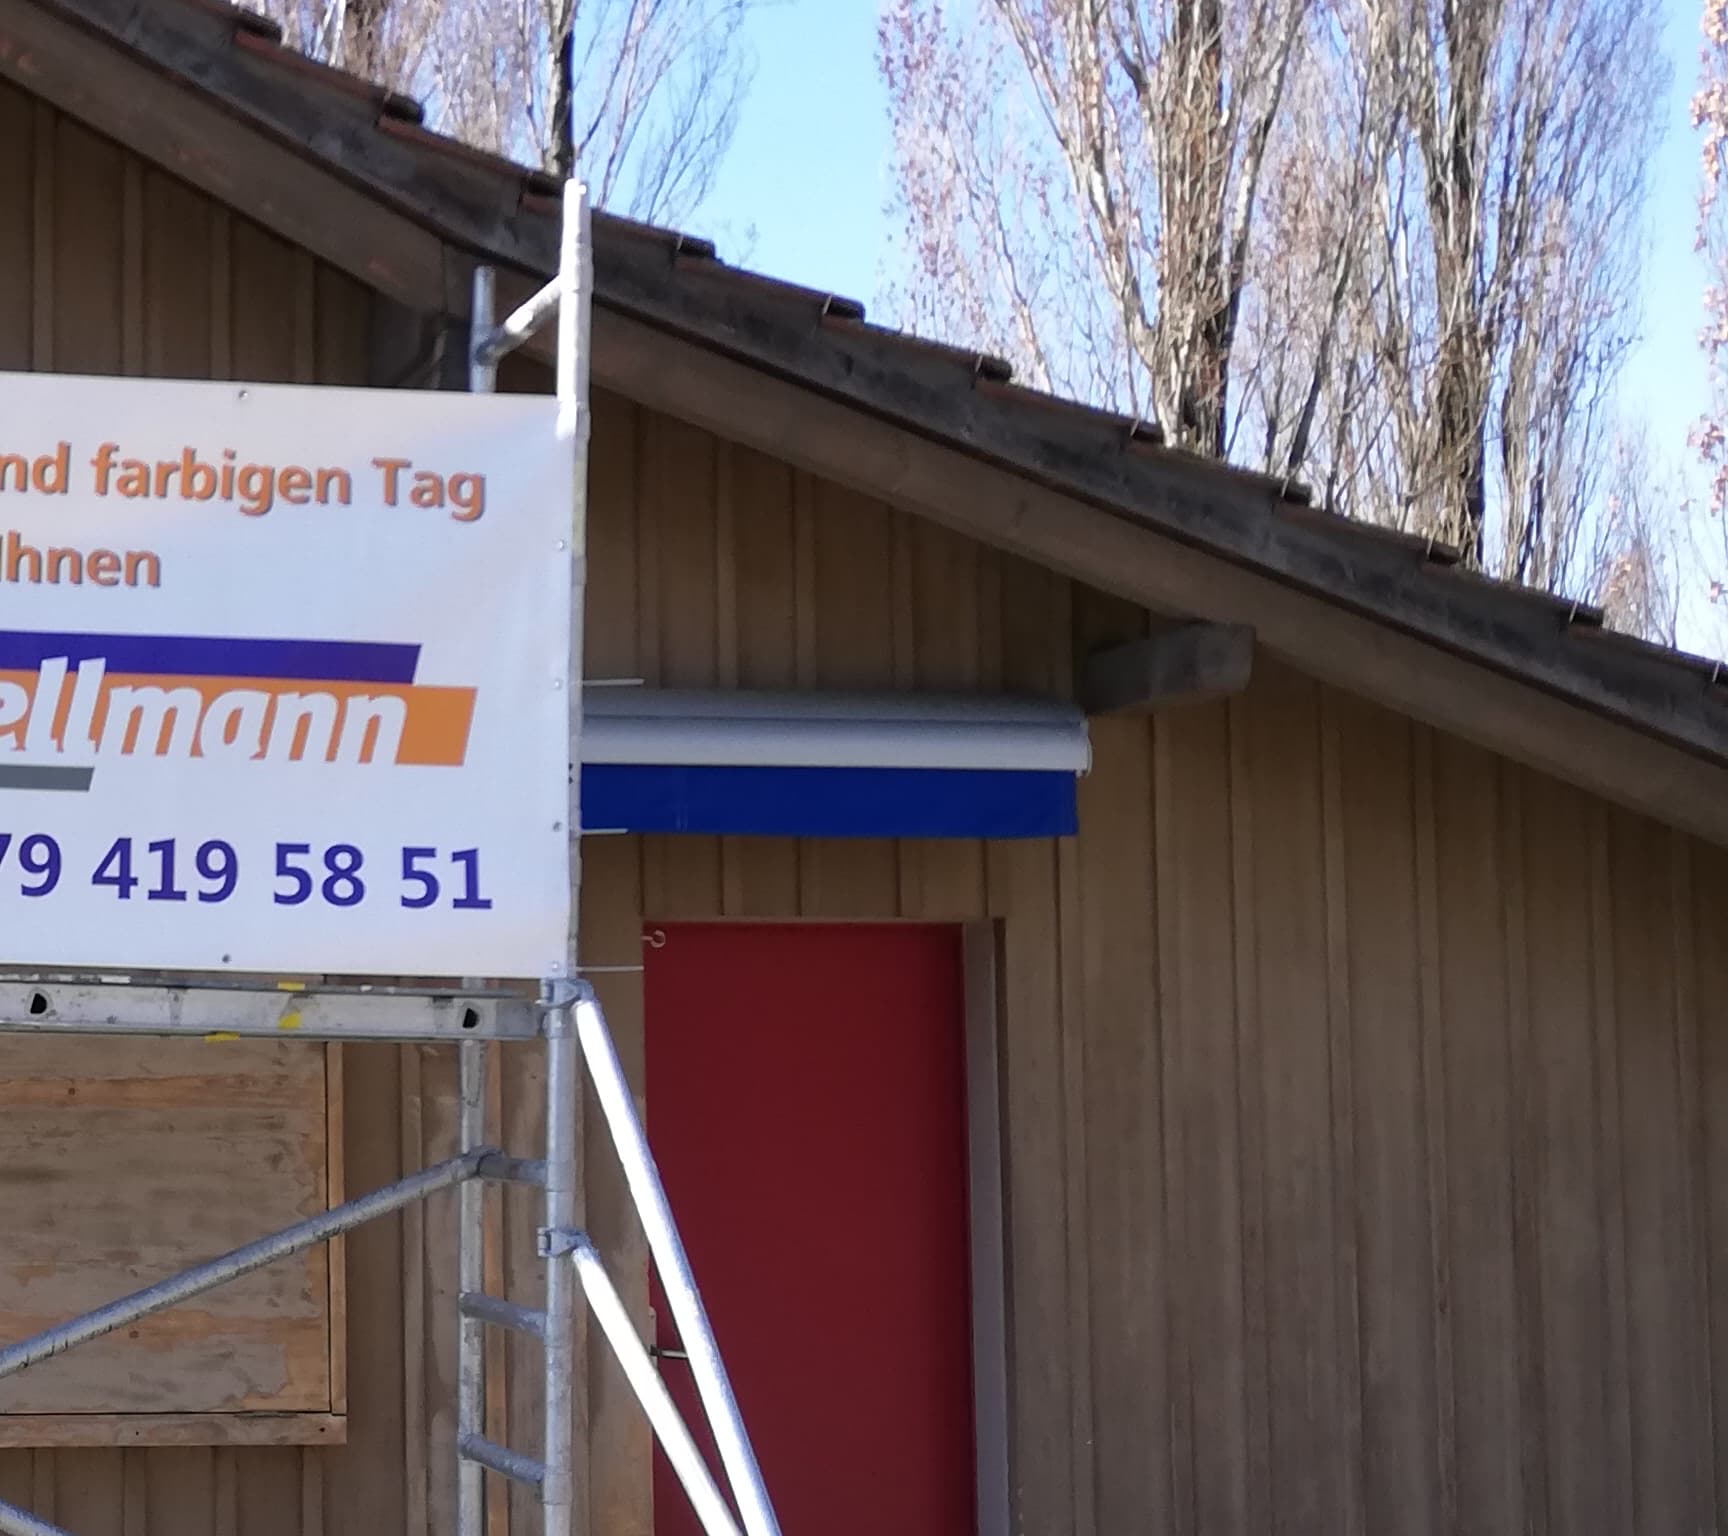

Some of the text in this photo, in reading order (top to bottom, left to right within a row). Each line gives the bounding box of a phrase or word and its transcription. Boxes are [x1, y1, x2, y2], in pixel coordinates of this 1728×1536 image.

[90, 442, 352, 517] farbigen
[372, 457, 487, 522] Tag
[91, 838, 239, 904] 419
[273, 843, 366, 907] 58
[401, 847, 492, 910] 51
